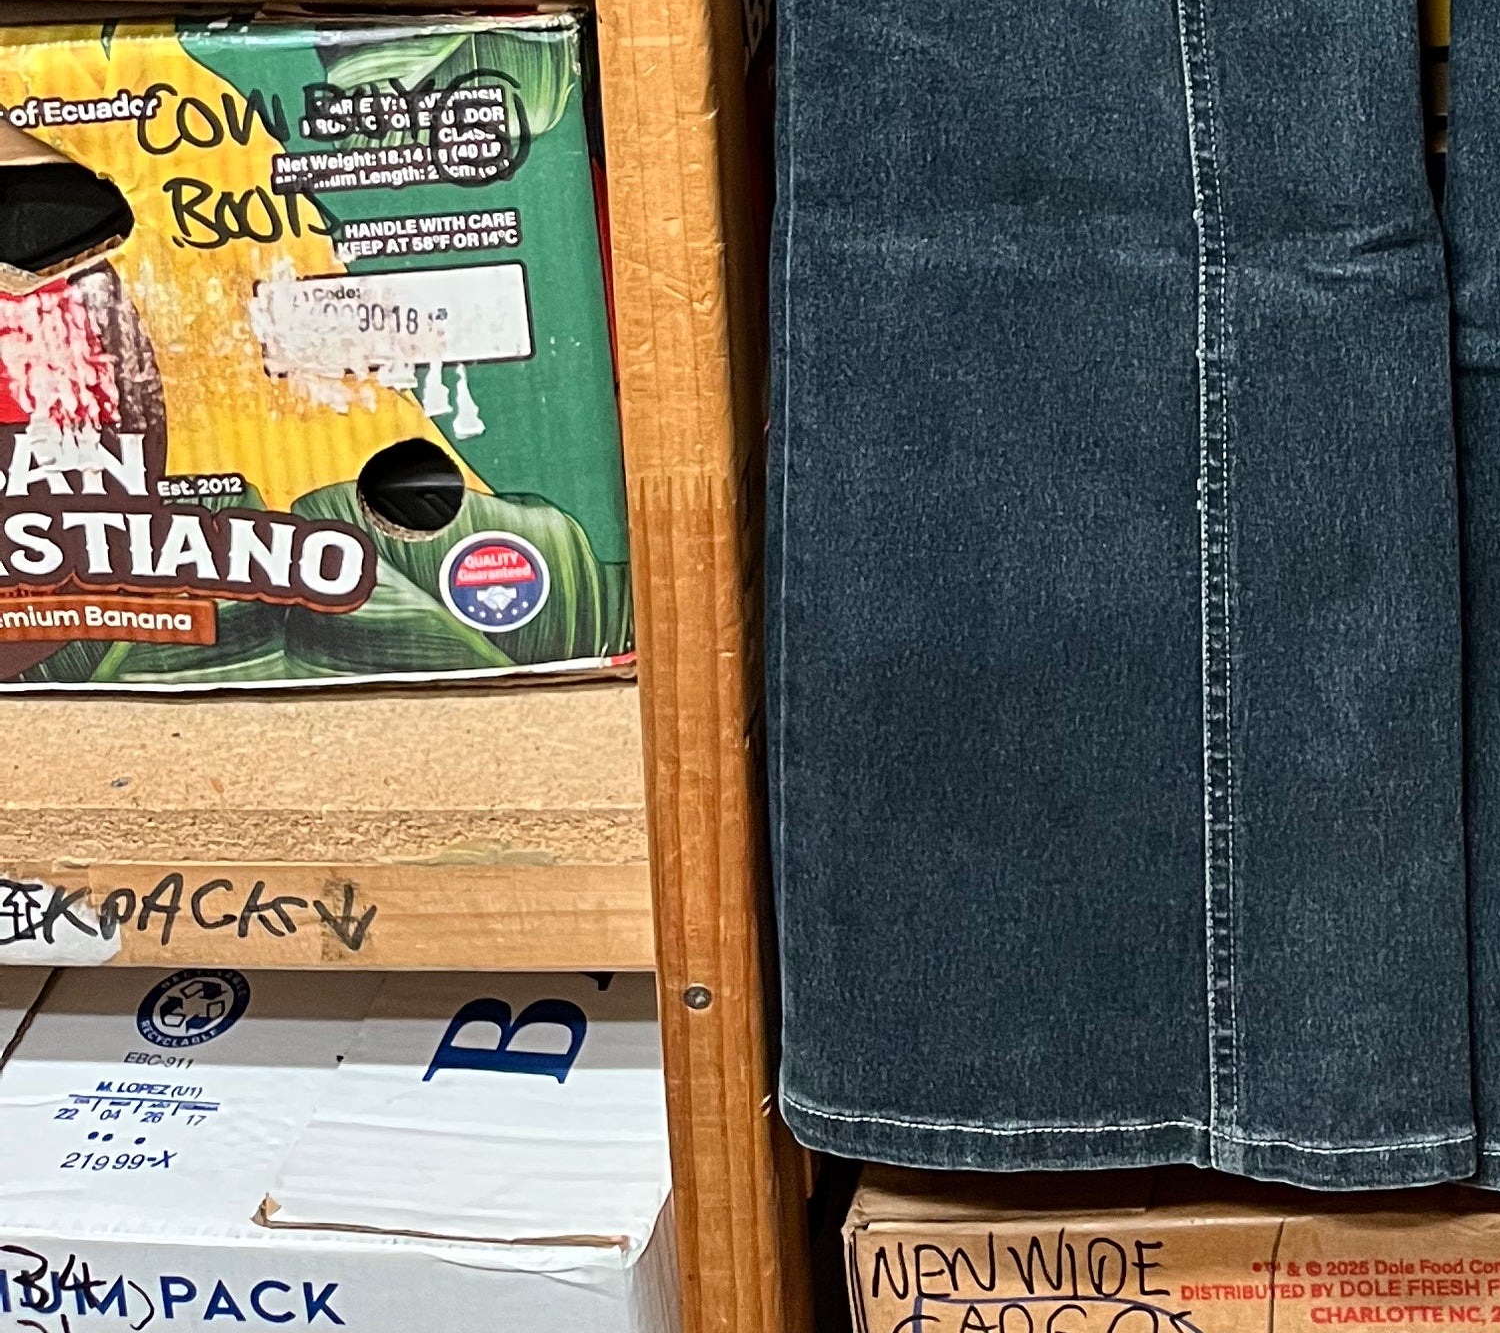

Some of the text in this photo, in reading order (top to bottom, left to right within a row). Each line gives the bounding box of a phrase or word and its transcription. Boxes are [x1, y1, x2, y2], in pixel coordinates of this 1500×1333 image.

[309, 150, 377, 172] Weight:
[345, 211, 517, 239] HANDLE WITH CARE
[386, 231, 480, 254] AT OR
[0, 434, 148, 497] AN
[157, 476, 242, 498] Est. 2012
[0, 512, 364, 597] STIANO
[464, 552, 519, 569] QUALITY
[85, 604, 192, 632] Banana
[116, 1081, 171, 1096] LOPEZ
[1008, 1227, 1170, 1299] WIDE
[1375, 1259, 1415, 1276] Dole
[1419, 1258, 1465, 1275] Food
[160, 1275, 346, 1326] PACK
[1180, 1284, 1306, 1301] DISTRIBUTED
[1340, 1280, 1402, 1298] DOLE
[1407, 1278, 1481, 1297] FRESH
[1309, 1306, 1445, 1325] CHARLOTTE
